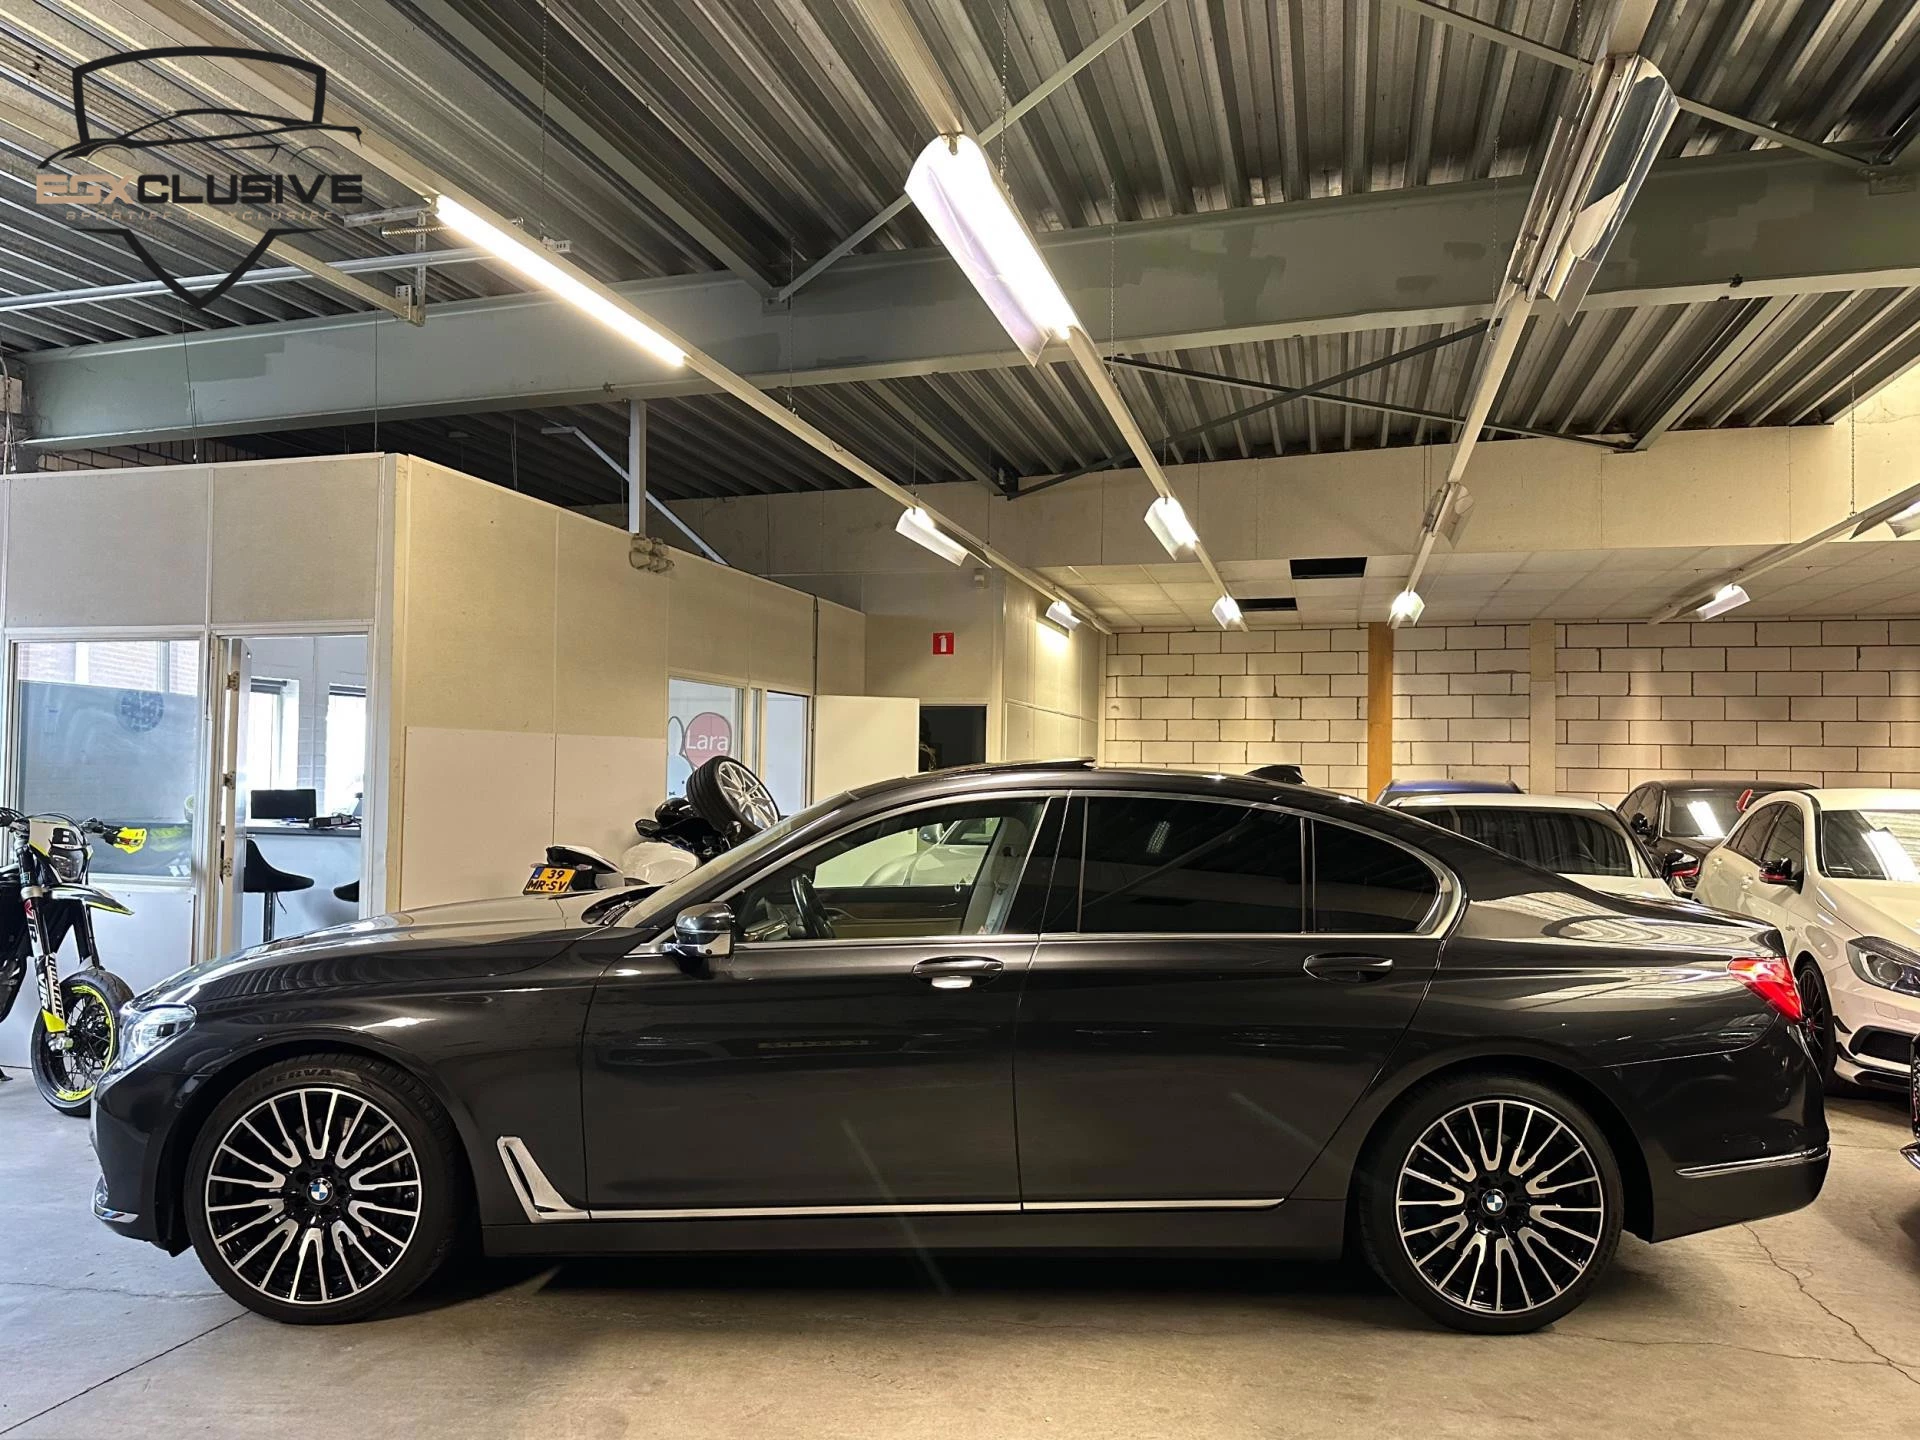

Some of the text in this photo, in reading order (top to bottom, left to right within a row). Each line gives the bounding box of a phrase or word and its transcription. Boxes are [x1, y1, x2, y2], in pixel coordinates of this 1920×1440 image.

[686, 729, 729, 751] Lara
[547, 869, 566, 880] 39
[526, 880, 568, 891] MR-SV
[48, 955, 65, 1022] DUNLOP
